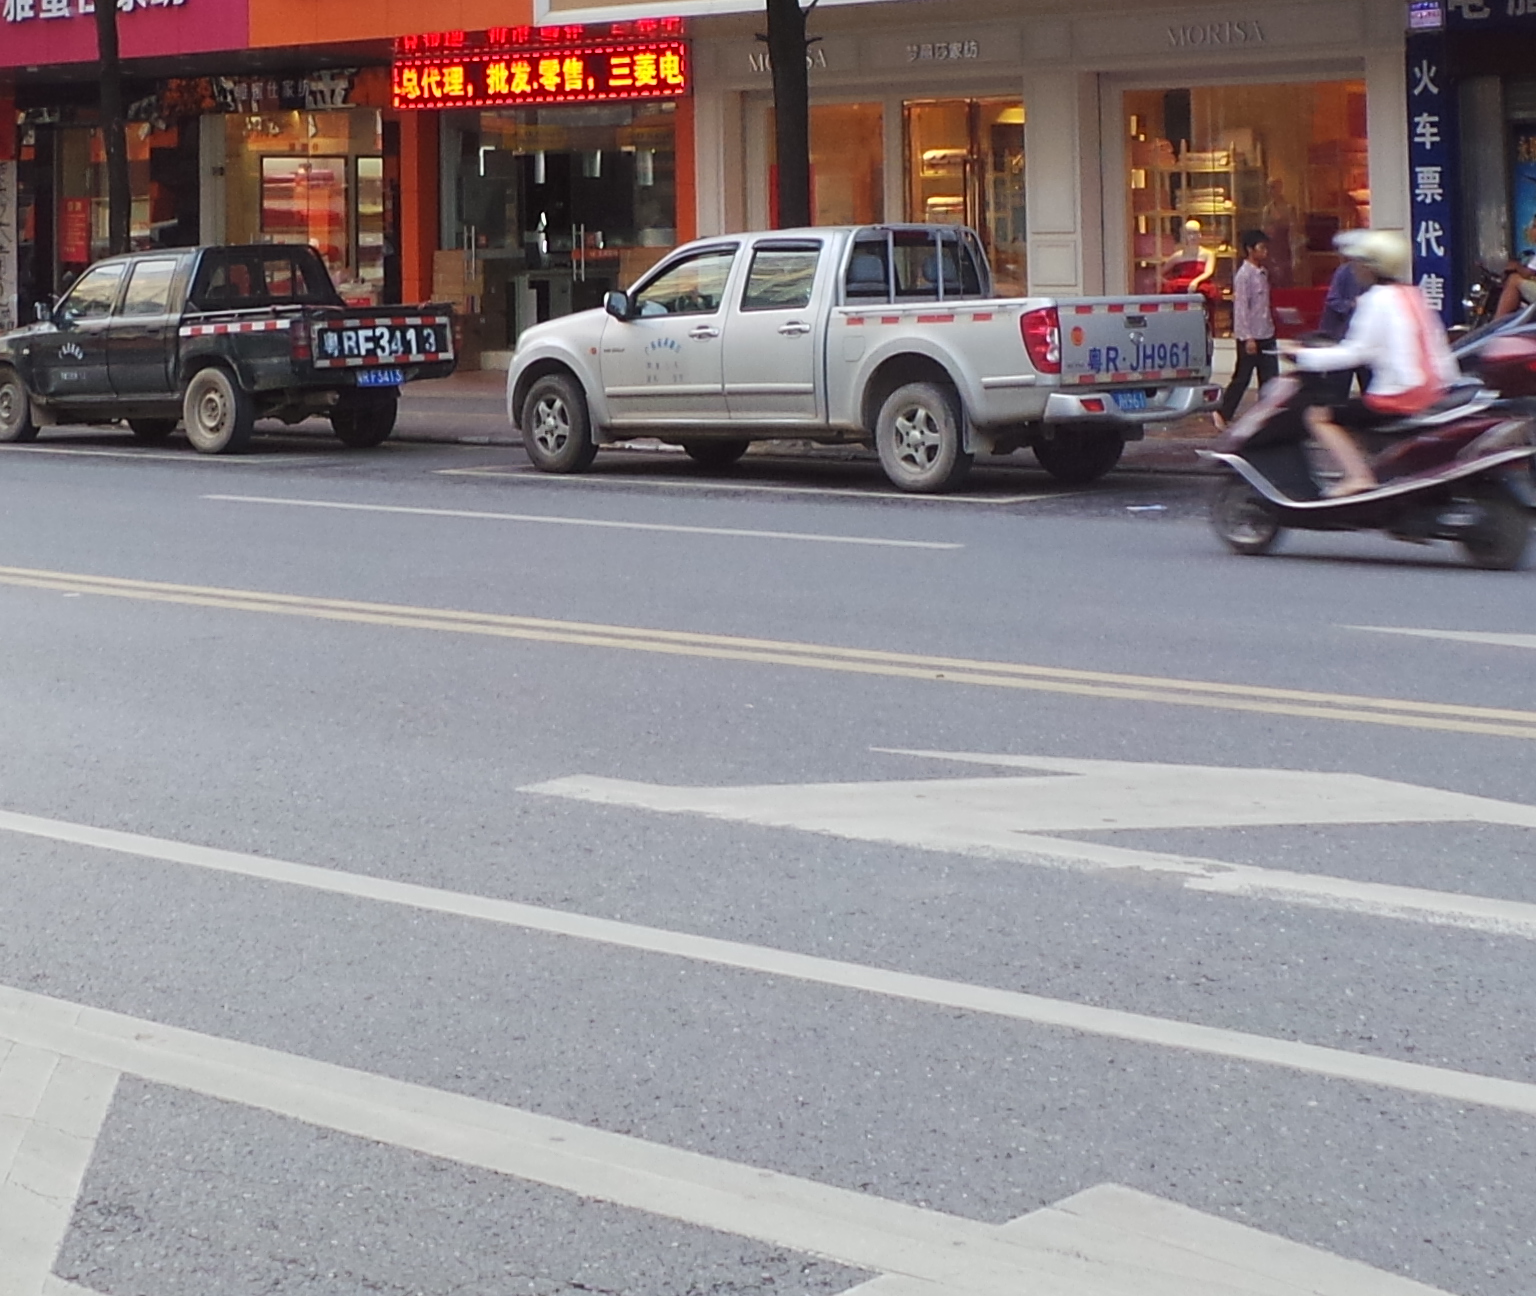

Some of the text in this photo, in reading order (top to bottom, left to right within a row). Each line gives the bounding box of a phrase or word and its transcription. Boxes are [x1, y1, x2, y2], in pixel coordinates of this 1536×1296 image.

[1166, 19, 1266, 48] MORISA
[748, 46, 828, 74] MOSA
[1412, 59, 1445, 313] 火车票代售
